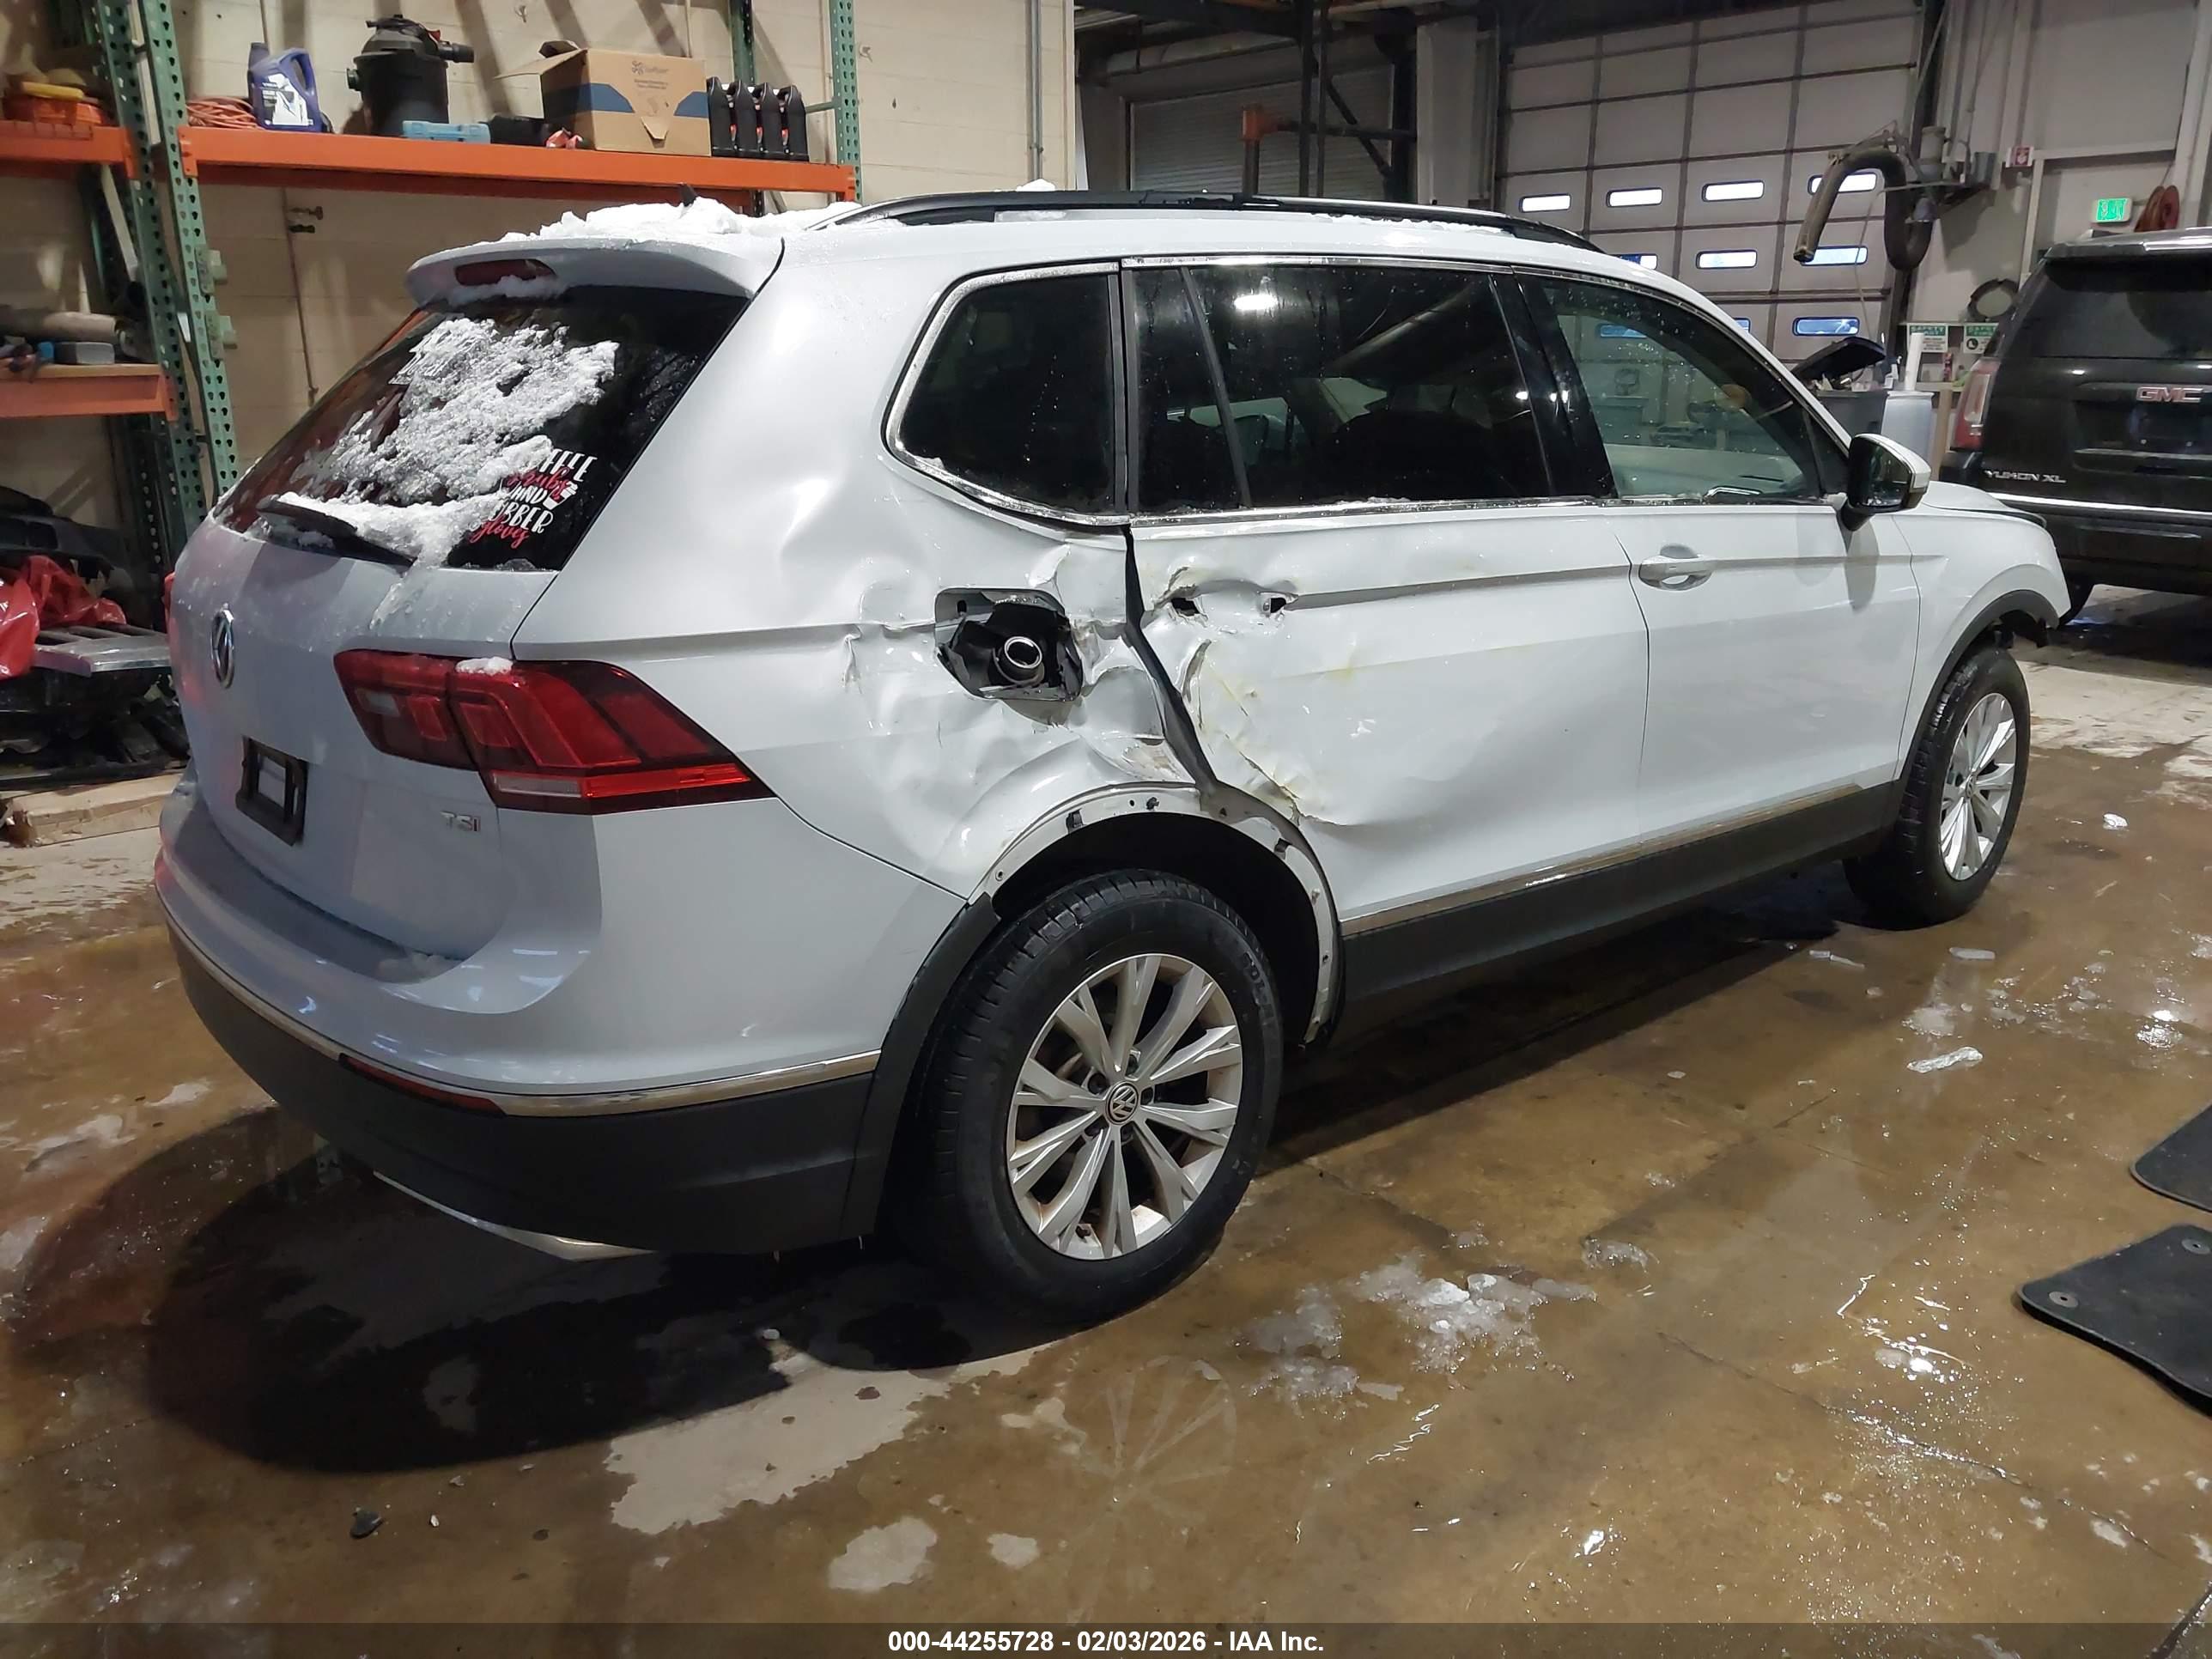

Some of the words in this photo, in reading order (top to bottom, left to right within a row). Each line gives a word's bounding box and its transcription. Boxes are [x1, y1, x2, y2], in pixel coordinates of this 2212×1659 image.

[2136, 386, 2203, 403] GMC
[538, 448, 598, 482] FFEE
[1984, 471, 2040, 482] YUKON
[2042, 474, 2067, 483] XL
[510, 485, 548, 504] AND
[488, 500, 554, 533] UBBER
[440, 811, 481, 832] TSI
